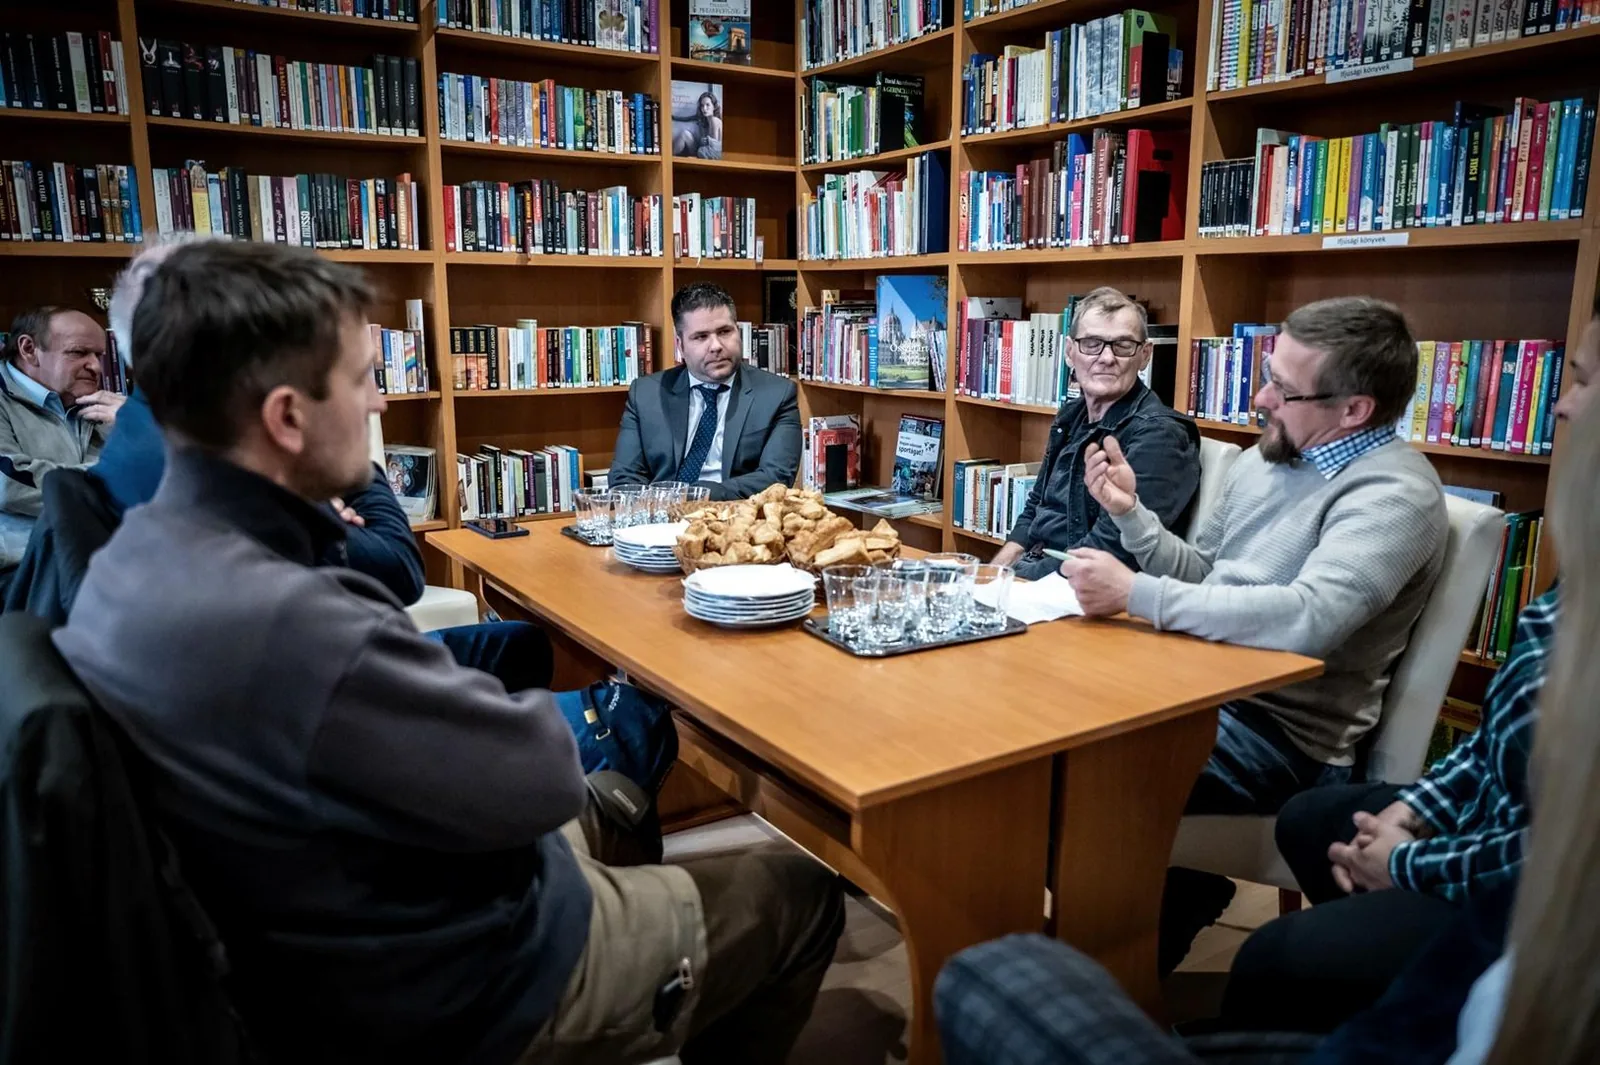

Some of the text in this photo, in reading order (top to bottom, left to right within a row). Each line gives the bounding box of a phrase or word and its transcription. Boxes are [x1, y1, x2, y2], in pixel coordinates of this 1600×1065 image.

[1340, 64, 1390, 78] Ifjúsági könyvek
[899, 447, 924, 456] sportágat?
